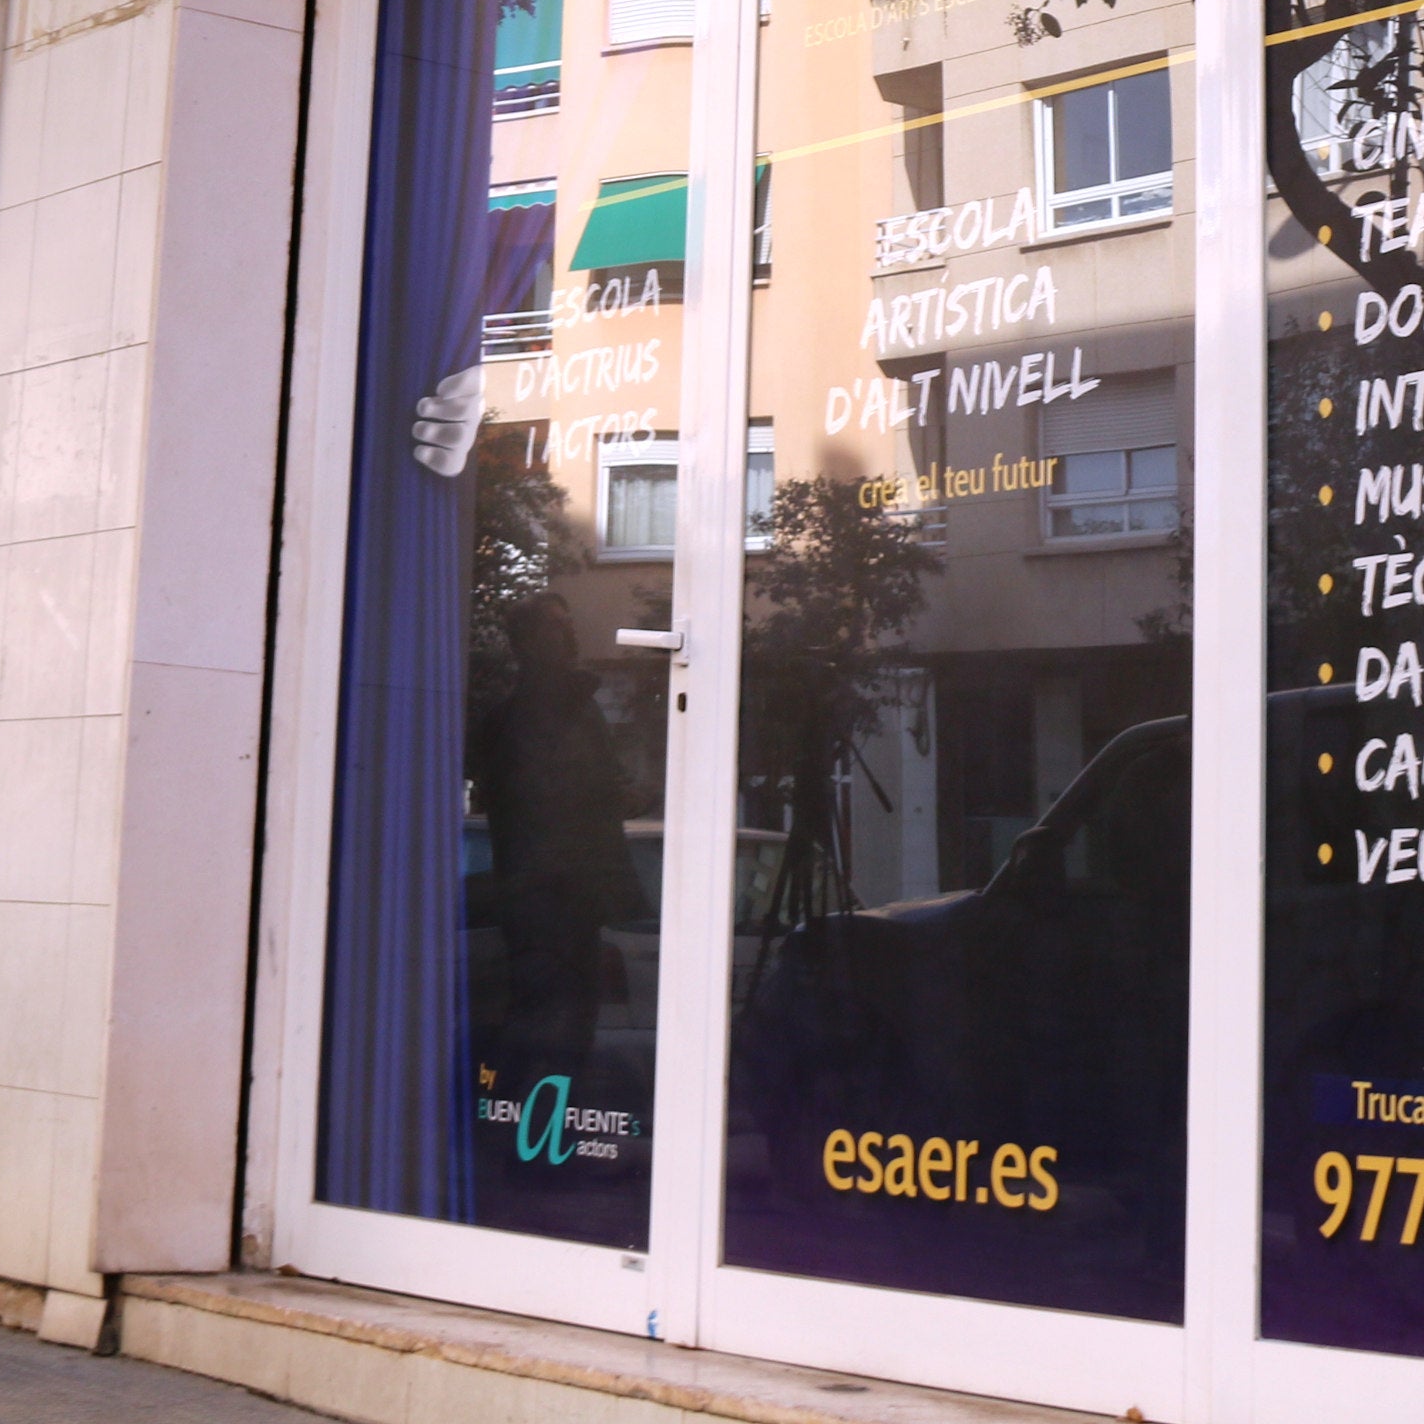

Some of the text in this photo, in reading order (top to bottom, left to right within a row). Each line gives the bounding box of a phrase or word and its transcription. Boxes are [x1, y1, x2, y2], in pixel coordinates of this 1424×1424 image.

[804, 14, 869, 48] ESCOLA
[877, 186, 1041, 266] ESCOLA
[549, 268, 663, 329] ESCOLA
[859, 265, 1059, 354] ARTÍSTICA
[514, 338, 662, 403] D'ACTRIUS
[825, 347, 1101, 436] D'ALT NIVELL
[525, 407, 659, 469] I ACTORS
[858, 452, 1059, 509] crea el teu futur
[479, 1062, 497, 1090] by
[576, 1138, 619, 1160] actors
[822, 1128, 1059, 1212] esaer.es
